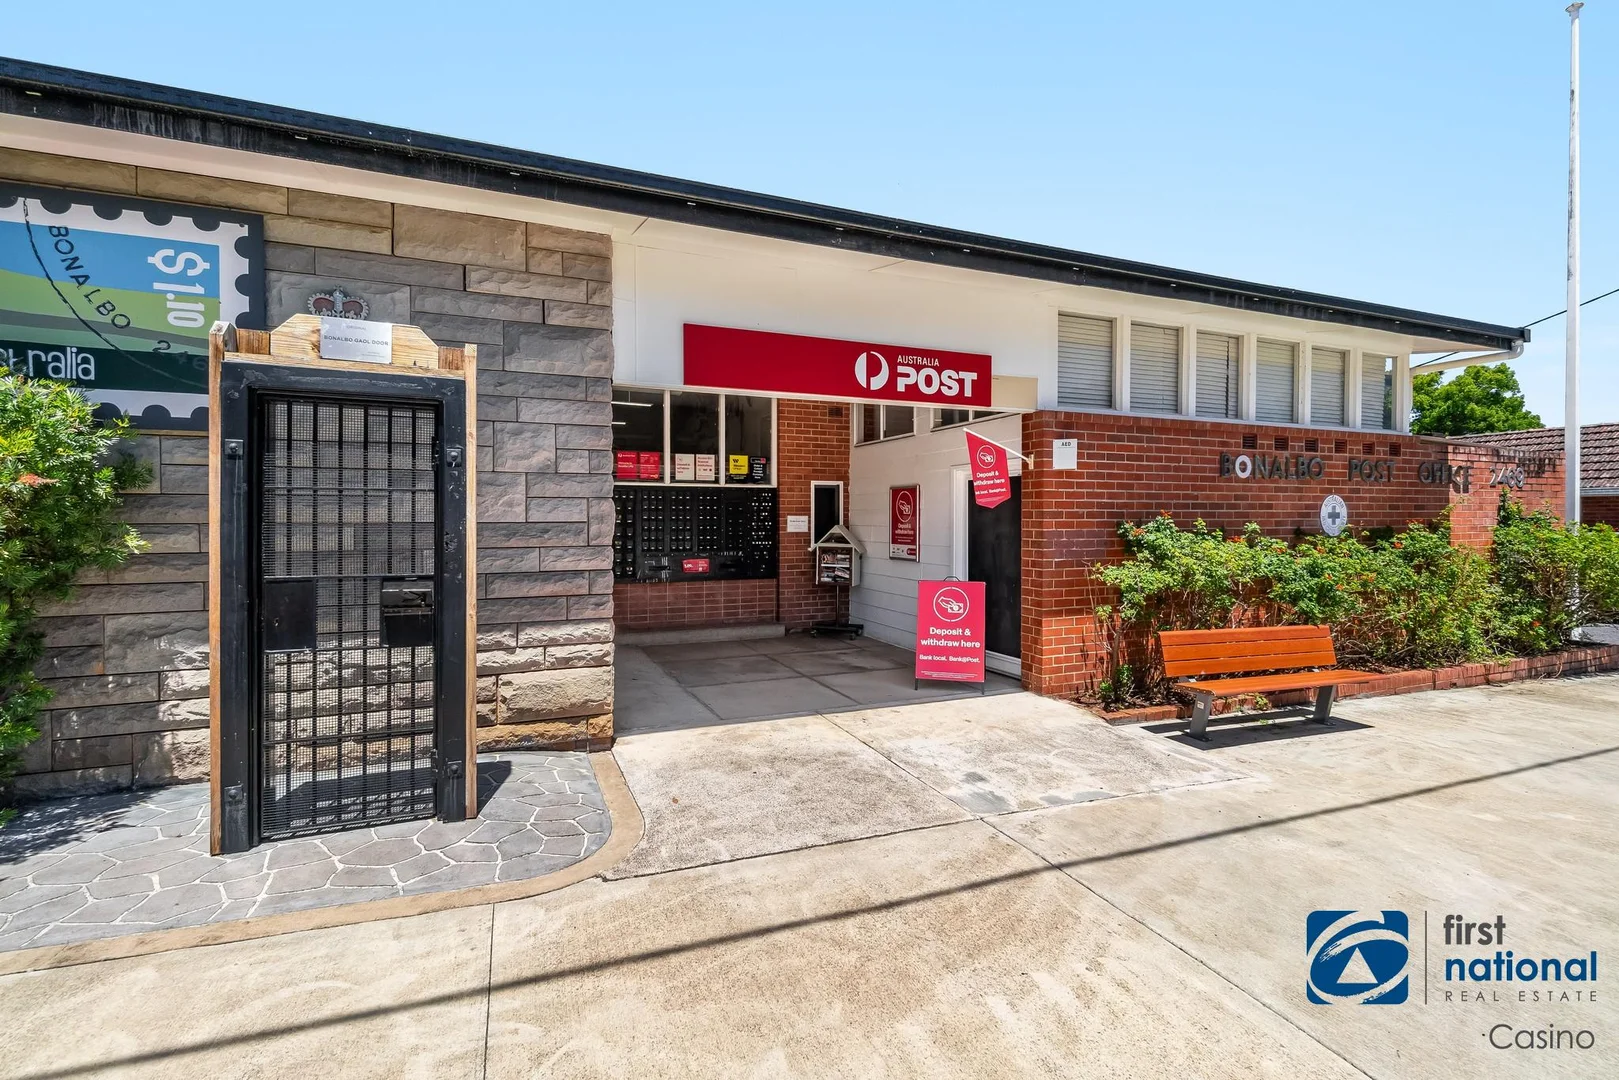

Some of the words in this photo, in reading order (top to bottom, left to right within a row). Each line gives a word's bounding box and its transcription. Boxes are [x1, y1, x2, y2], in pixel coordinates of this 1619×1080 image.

[48, 225, 131, 329] BONALBO
[147, 248, 211, 328] $1.10
[324, 334, 353, 343] BONALBO
[354, 337, 370, 345] GAOL
[896, 354, 940, 367] AUSTRALIA
[896, 365, 978, 397] POST
[1219, 452, 1324, 480] BONALBO
[1348, 459, 1396, 483] POST
[1489, 466, 1525, 488] 2469
[929, 626, 962, 636] Deposit
[964, 628, 971, 636] &
[920, 637, 960, 647] withdraw
[961, 639, 981, 648] here
